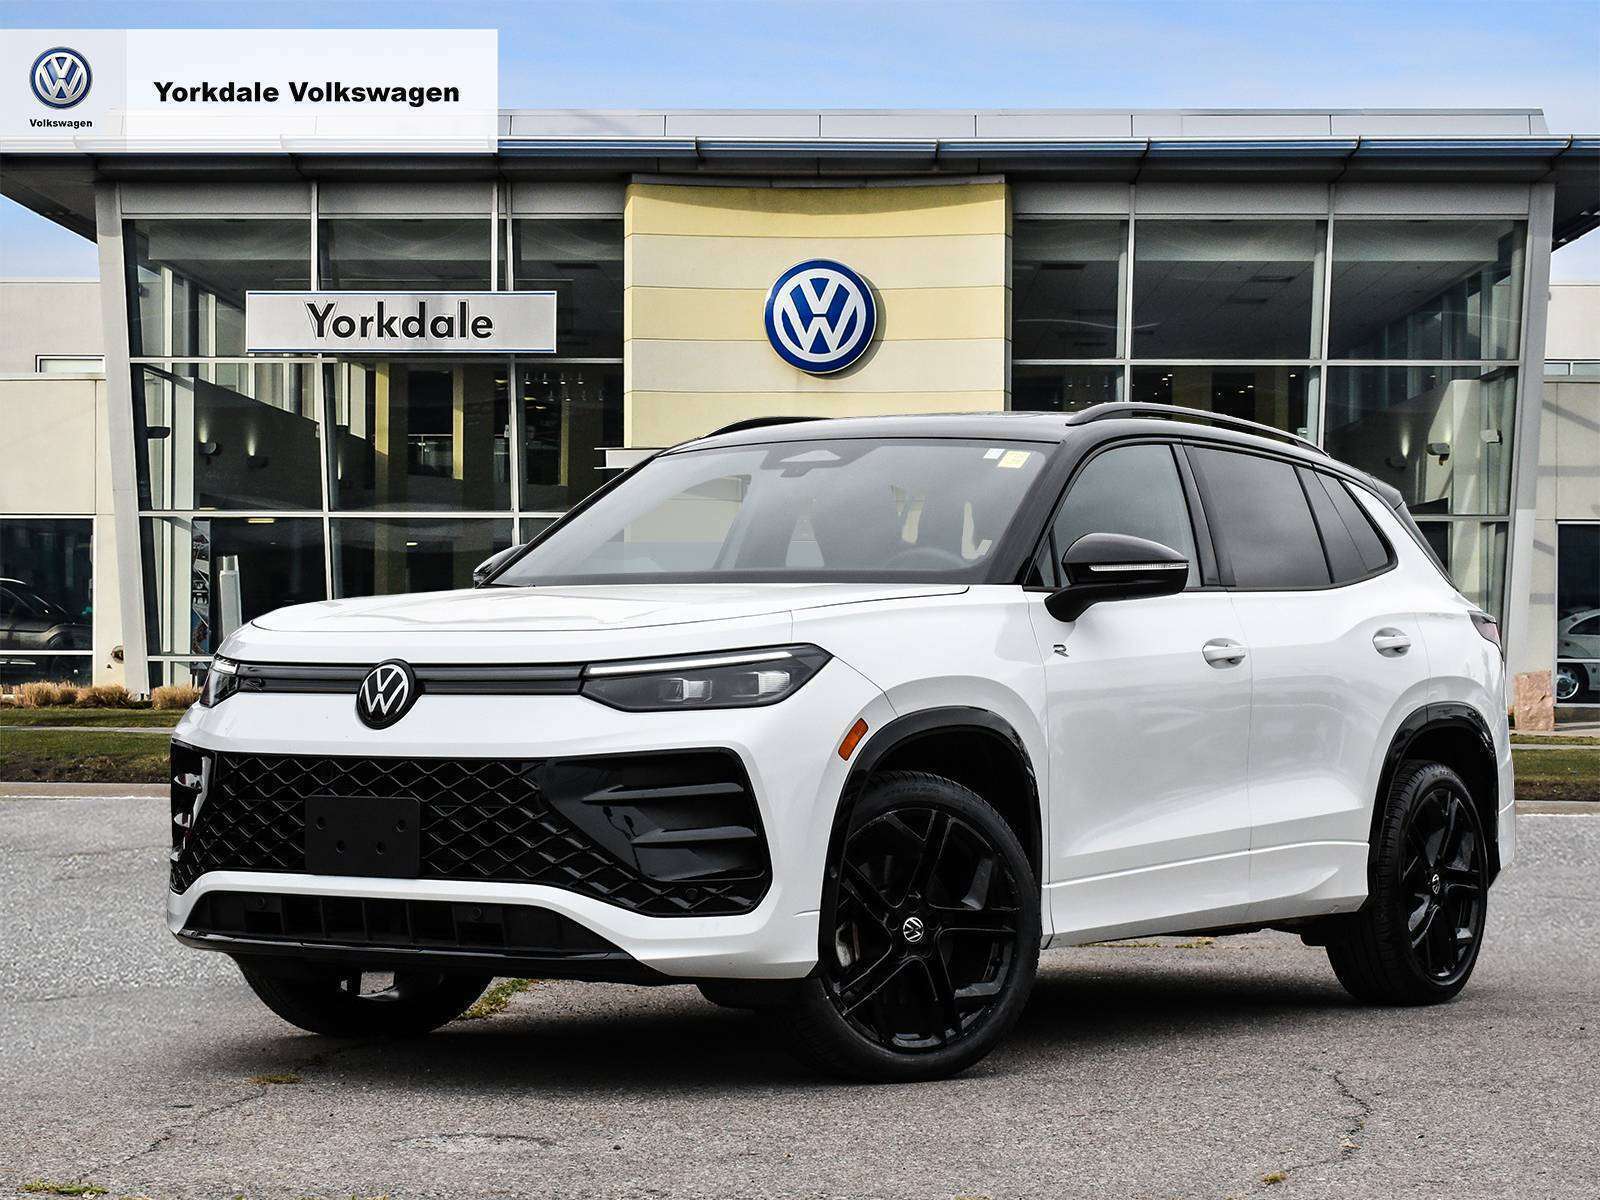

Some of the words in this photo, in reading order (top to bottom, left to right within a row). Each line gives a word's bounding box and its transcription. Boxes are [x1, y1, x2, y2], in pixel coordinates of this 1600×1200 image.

[306, 301, 494, 340] Yorkdale
[771, 266, 868, 364] VW
[359, 664, 409, 716] VW
